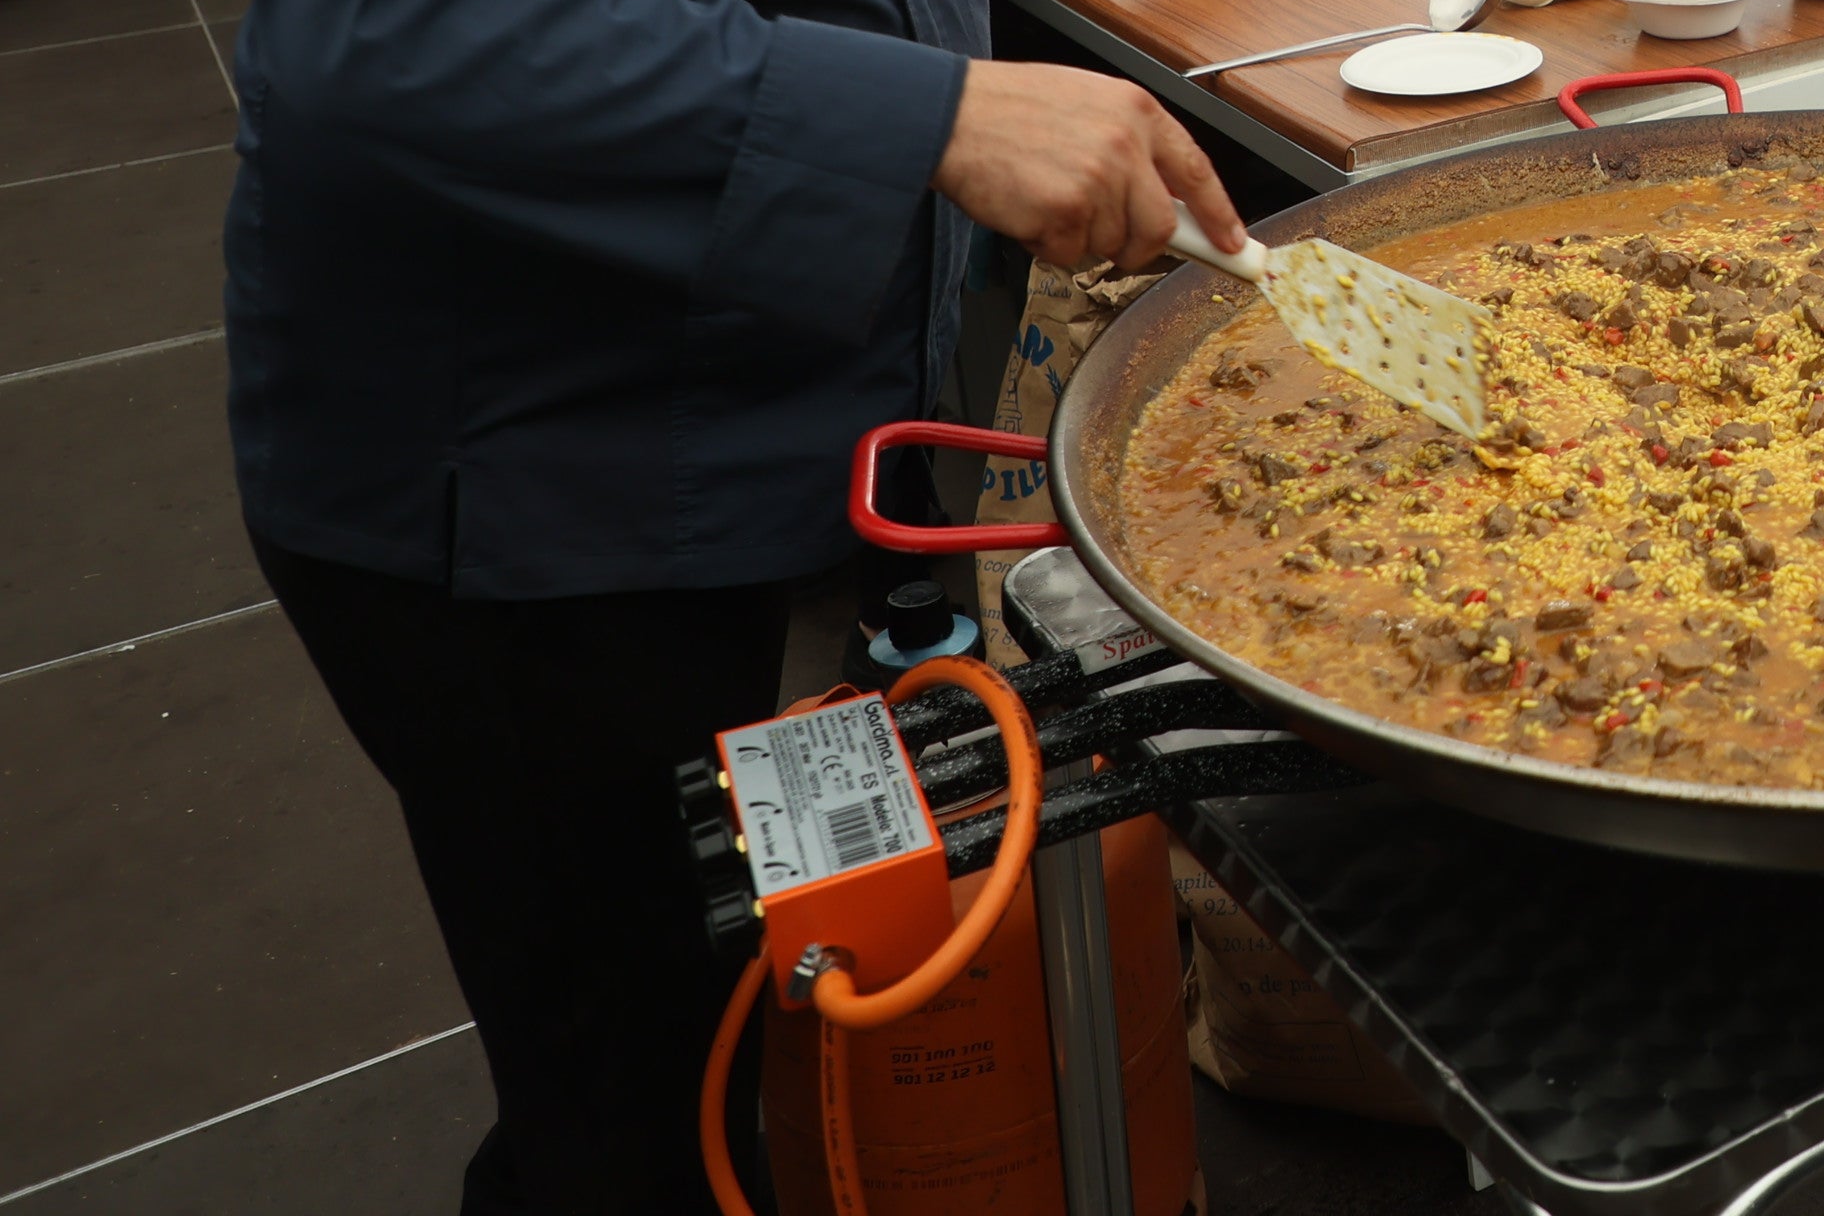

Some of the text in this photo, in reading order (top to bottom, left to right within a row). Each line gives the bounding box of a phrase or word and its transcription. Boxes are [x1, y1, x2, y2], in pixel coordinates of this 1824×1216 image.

[861, 772, 879, 790] ES
[883, 832, 903, 853] 700
[1204, 897, 1240, 916] 923
[1260, 974, 1281, 993] de
[894, 1061, 996, 1085] 901 12 12 12
